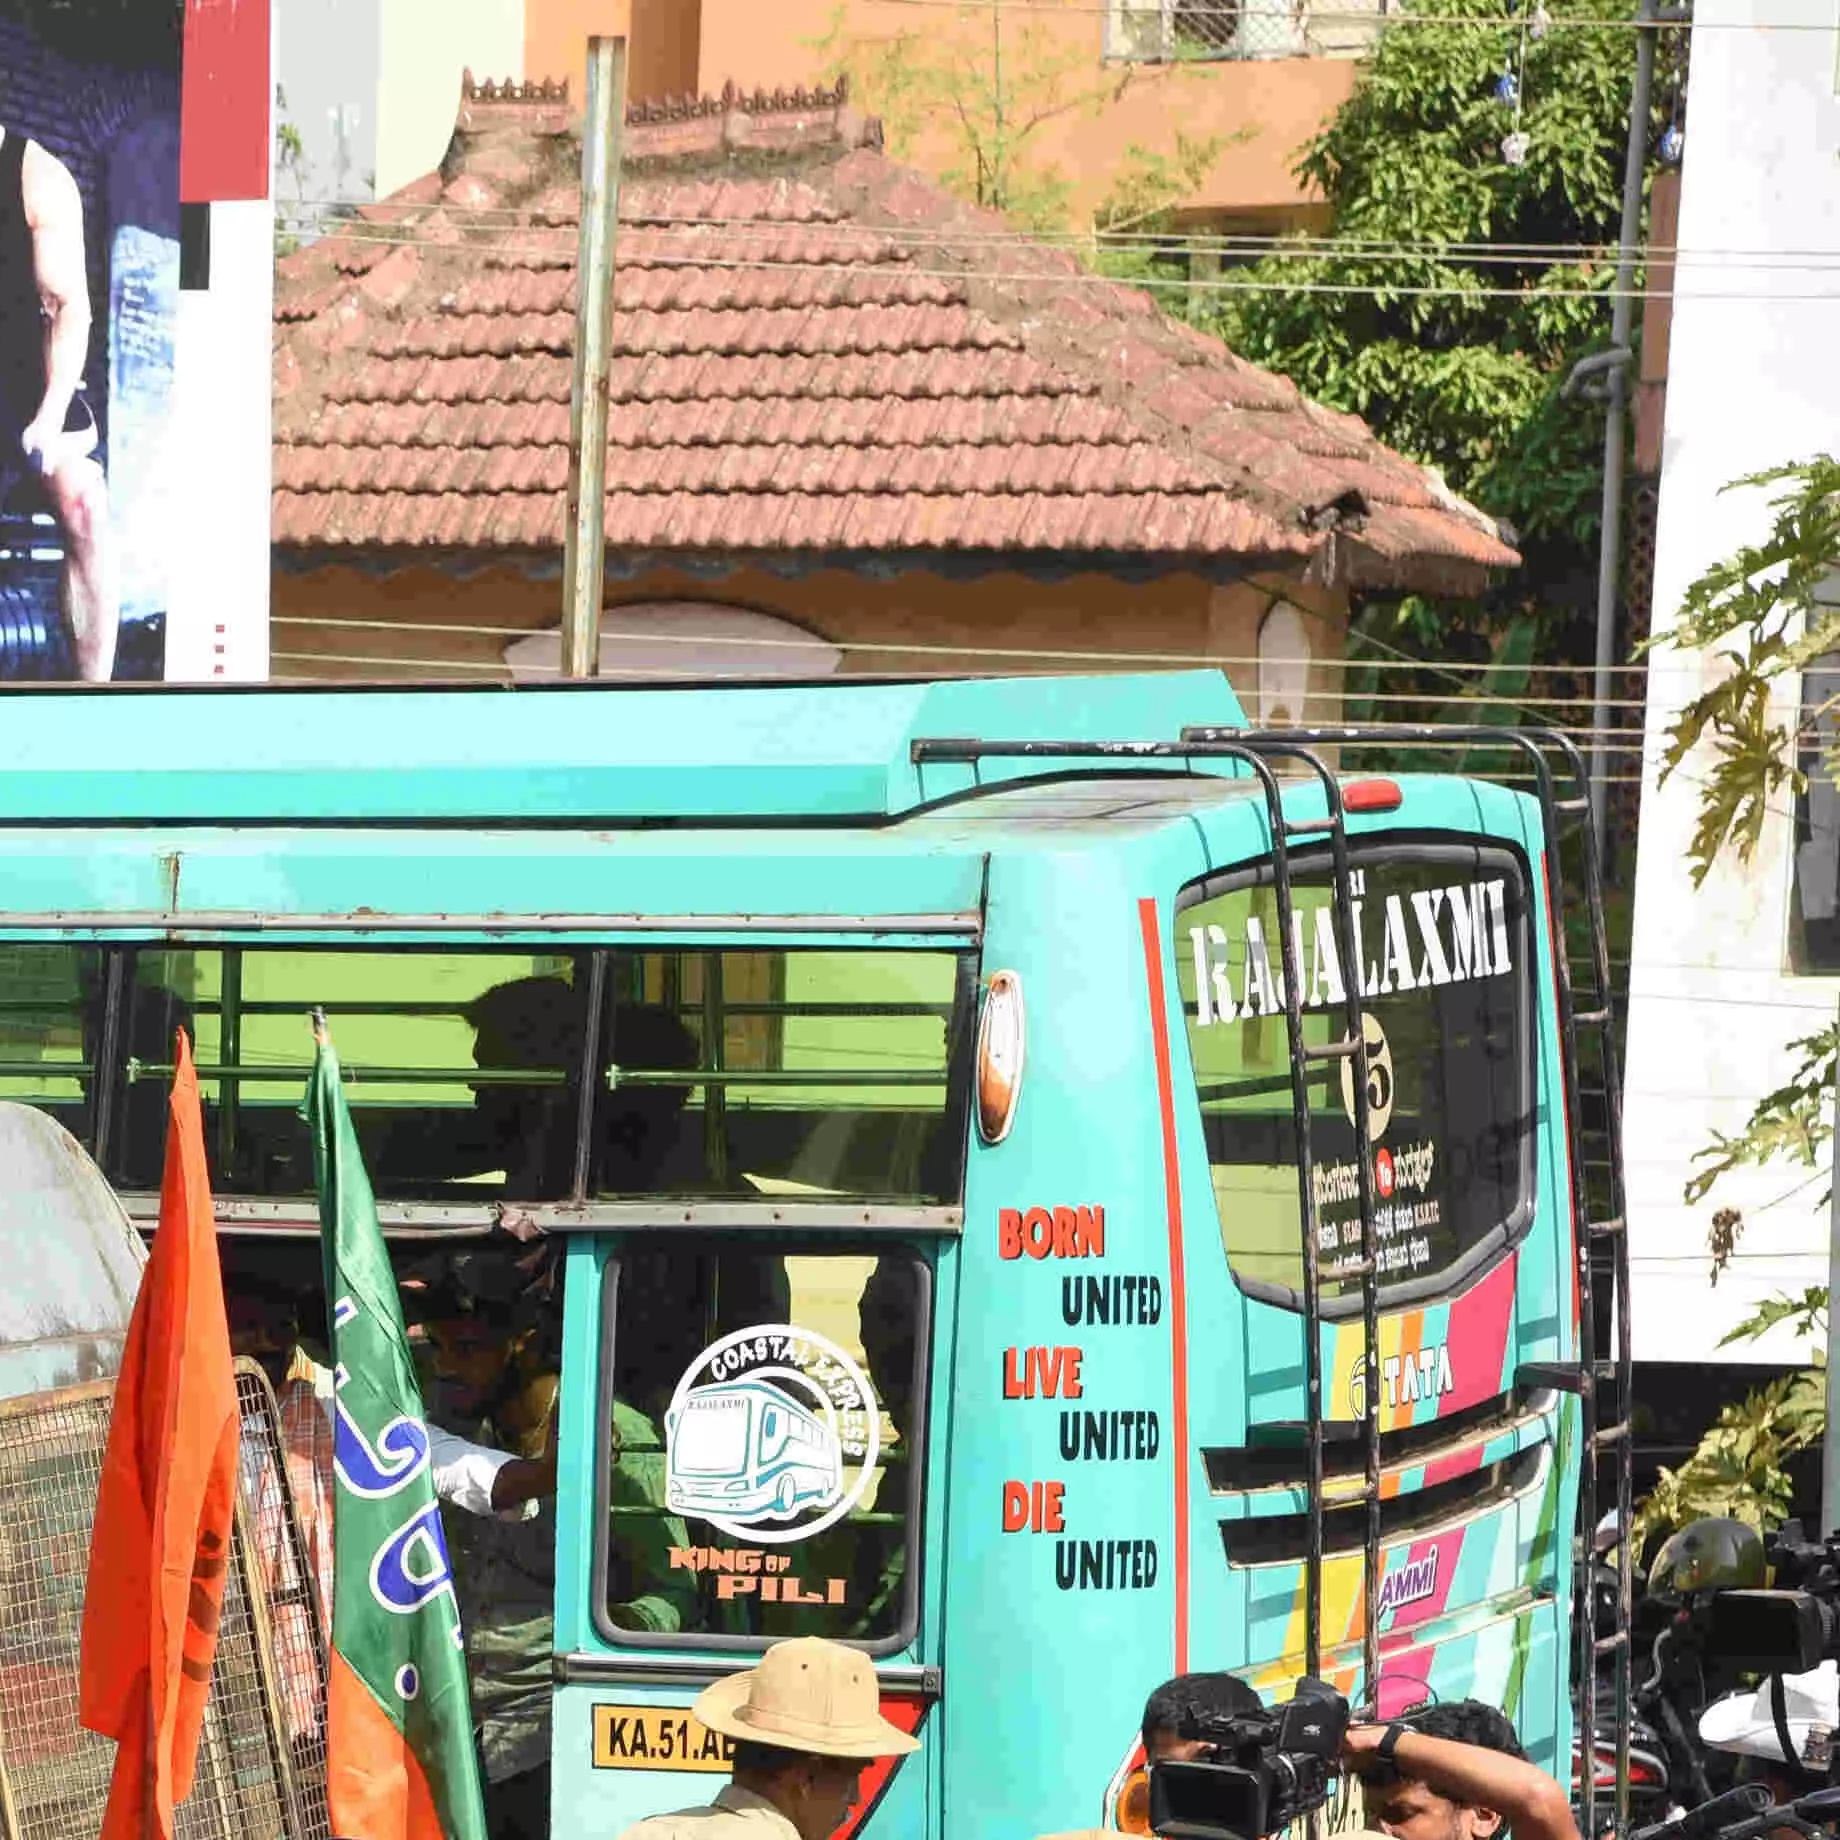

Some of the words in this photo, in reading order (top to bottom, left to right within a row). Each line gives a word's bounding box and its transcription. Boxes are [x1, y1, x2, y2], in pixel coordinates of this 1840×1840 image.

[998, 1205, 1105, 1261] BORN
[1061, 1275, 1162, 1327] UNITED
[1003, 1346, 1083, 1400] LIVE
[1383, 1343, 1455, 1408] TATA
[1059, 1410, 1160, 1462] UNITED
[1001, 1482, 1065, 1536] DIE
[668, 1546, 765, 1573] KING
[1055, 1539, 1158, 1591] UNITED
[716, 1574, 847, 1605] PILI
